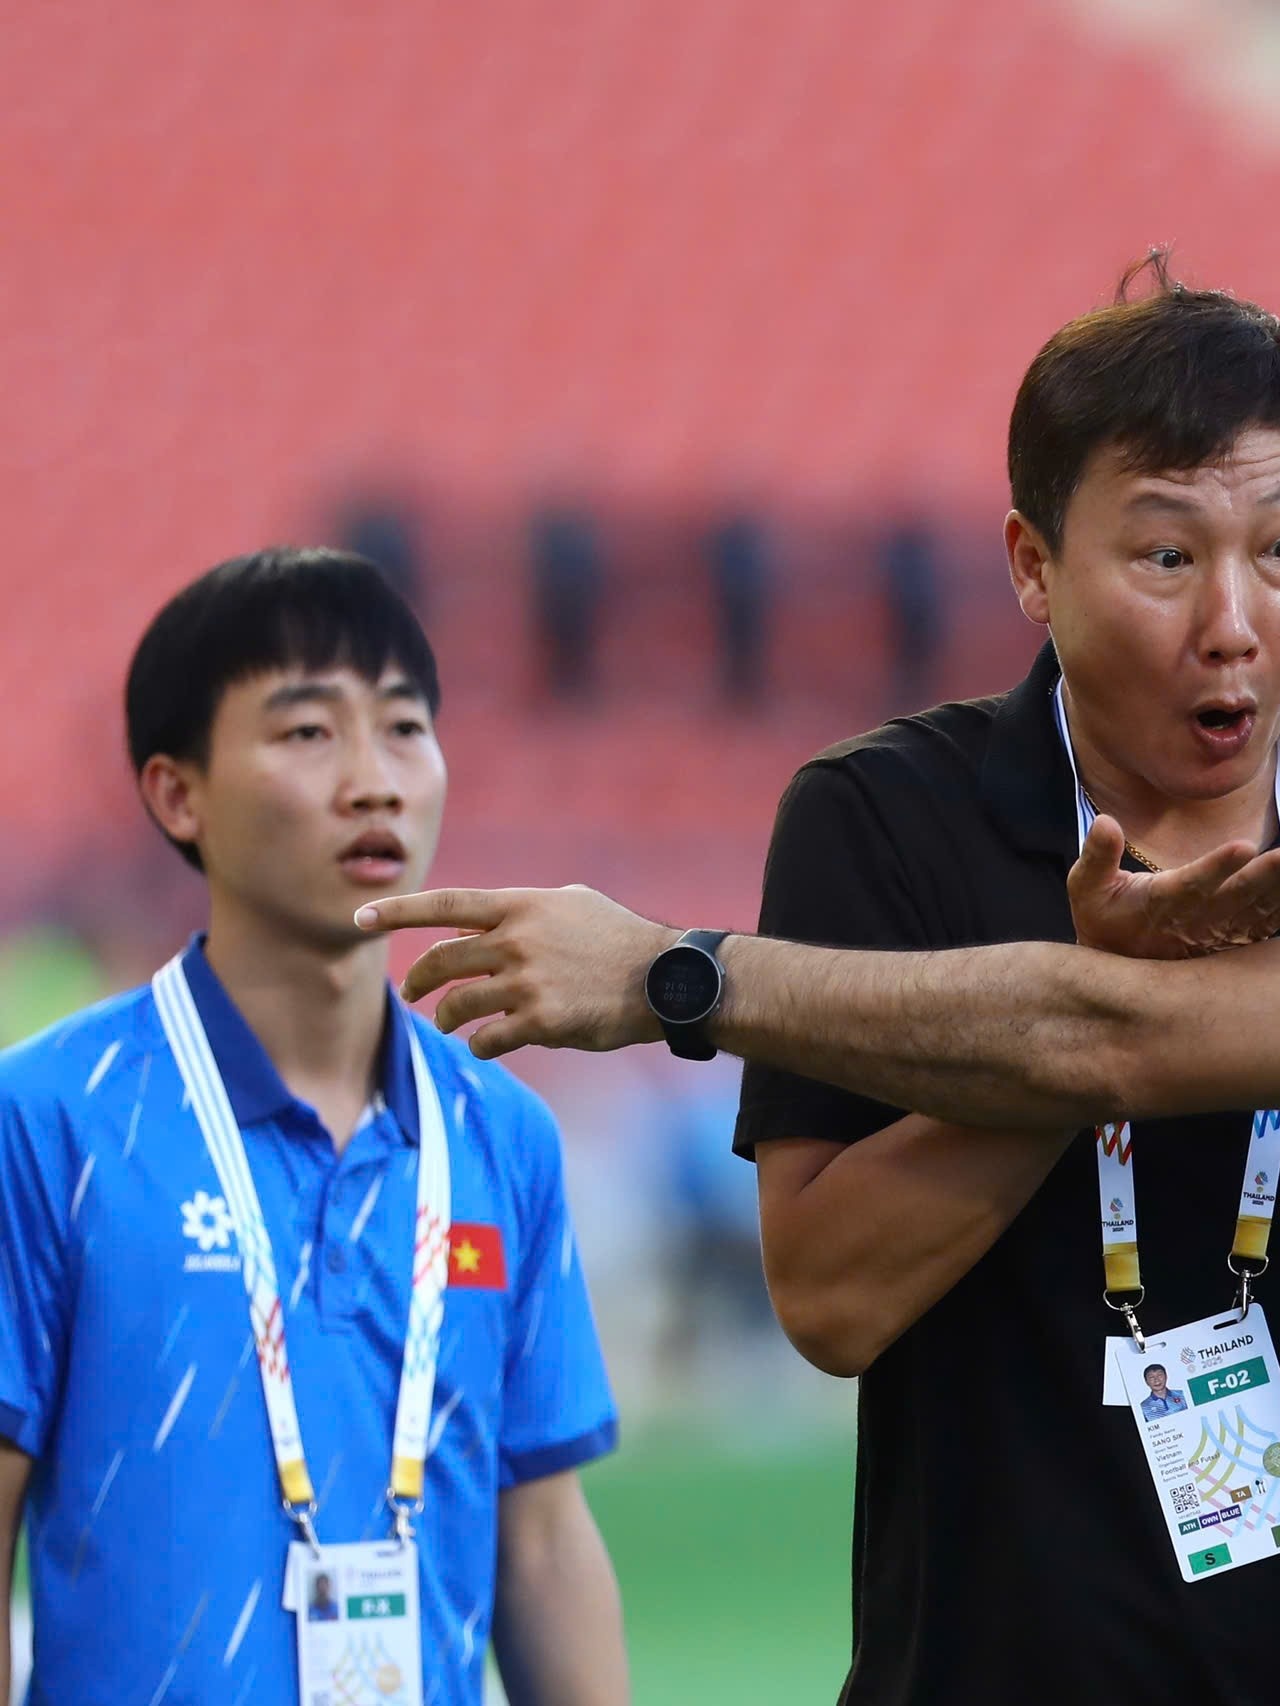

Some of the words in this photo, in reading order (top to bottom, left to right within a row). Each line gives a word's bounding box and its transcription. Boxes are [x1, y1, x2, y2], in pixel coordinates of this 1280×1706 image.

[1243, 1192, 1275, 1202] THAILAND
[1102, 1219, 1134, 1227] THAILAND
[1198, 1335, 1254, 1360] THAILAND
[1201, 1356, 1223, 1369] 2025
[1207, 1369, 1251, 1395] F-02
[1148, 1424, 1160, 1432] KIM
[1152, 1437, 1171, 1447] SANG
[1173, 1433, 1184, 1441] SIK
[1156, 1450, 1182, 1462] Vietnam
[1161, 1463, 1187, 1476] Football
[1188, 1459, 1199, 1468] and
[1200, 1452, 1221, 1464] Futsal
[1236, 1491, 1246, 1499] TA
[1182, 1522, 1197, 1532] ATH
[1201, 1515, 1219, 1525] OWN
[1222, 1508, 1240, 1518] BLUE
[1205, 1553, 1216, 1565] S
